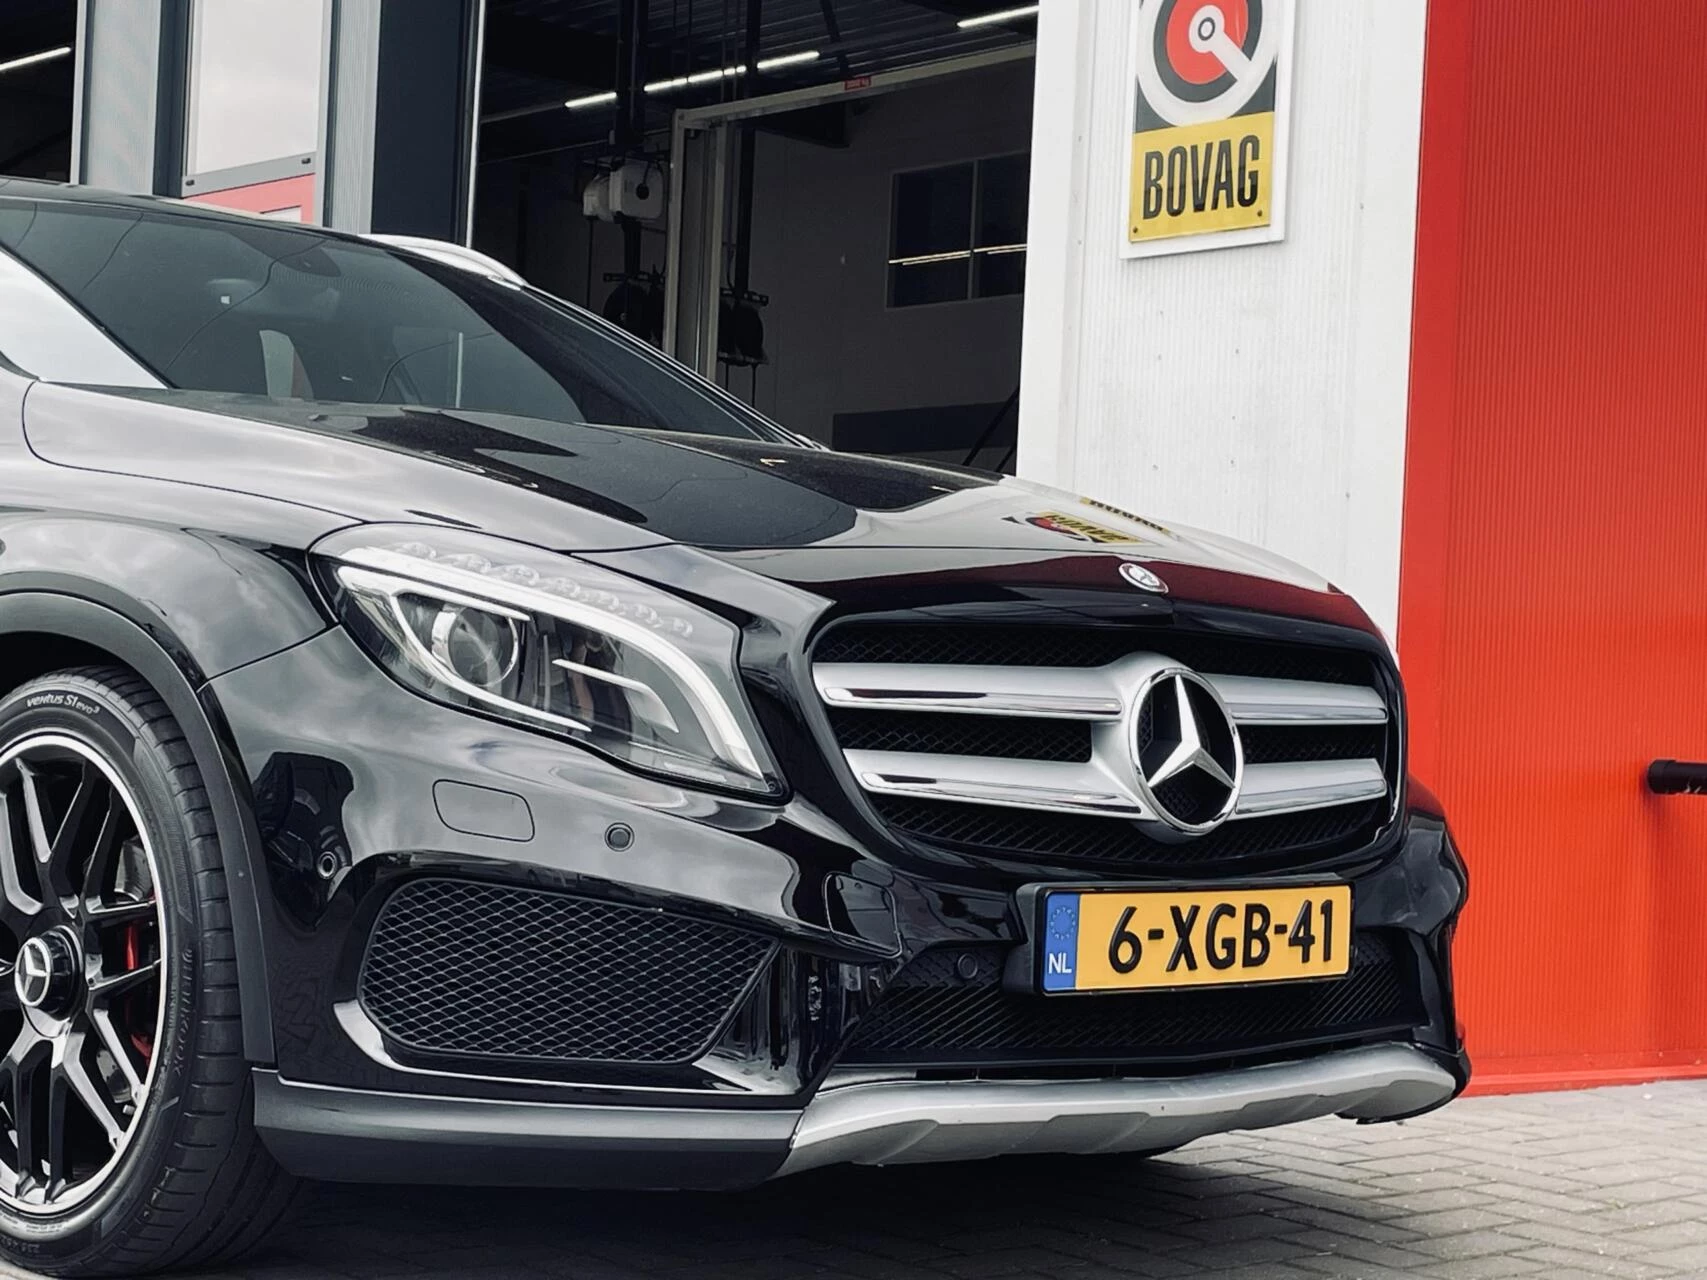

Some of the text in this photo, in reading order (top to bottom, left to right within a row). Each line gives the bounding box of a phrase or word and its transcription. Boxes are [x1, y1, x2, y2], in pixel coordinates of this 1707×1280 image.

[1143, 135, 1260, 219] BOVAG
[1048, 952, 1073, 974] NL
[1108, 900, 1333, 974] 6-XGB-41
